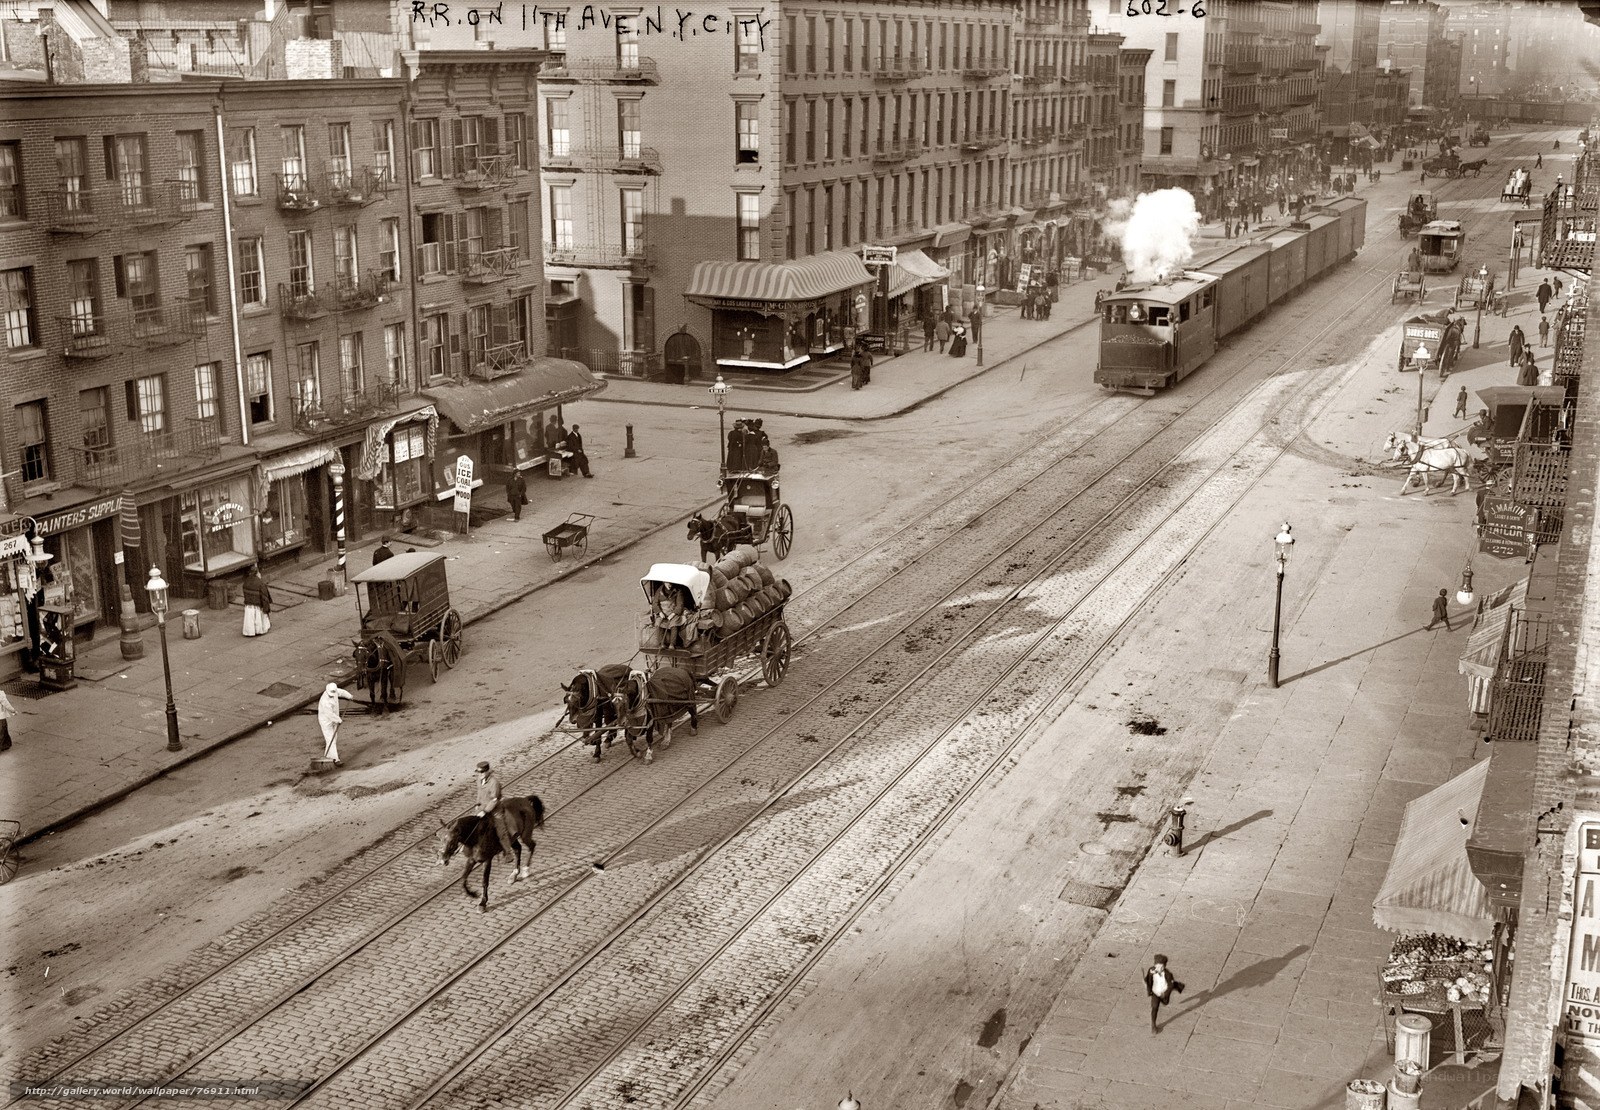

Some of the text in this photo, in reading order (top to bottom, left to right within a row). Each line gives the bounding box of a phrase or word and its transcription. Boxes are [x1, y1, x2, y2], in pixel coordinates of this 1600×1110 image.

[467, 1, 502, 26] ON
[702, 14, 771, 51] CITY
[458, 469, 472, 478] ICE
[456, 476, 471, 487] COAL
[455, 490, 471, 500] WOOD
[35, 496, 123, 535] PAINTERS SUPPLIE
[1488, 522, 1524, 538] TAILOR
[3, 540, 17, 551] 267
[1492, 545, 1514, 555] 272
